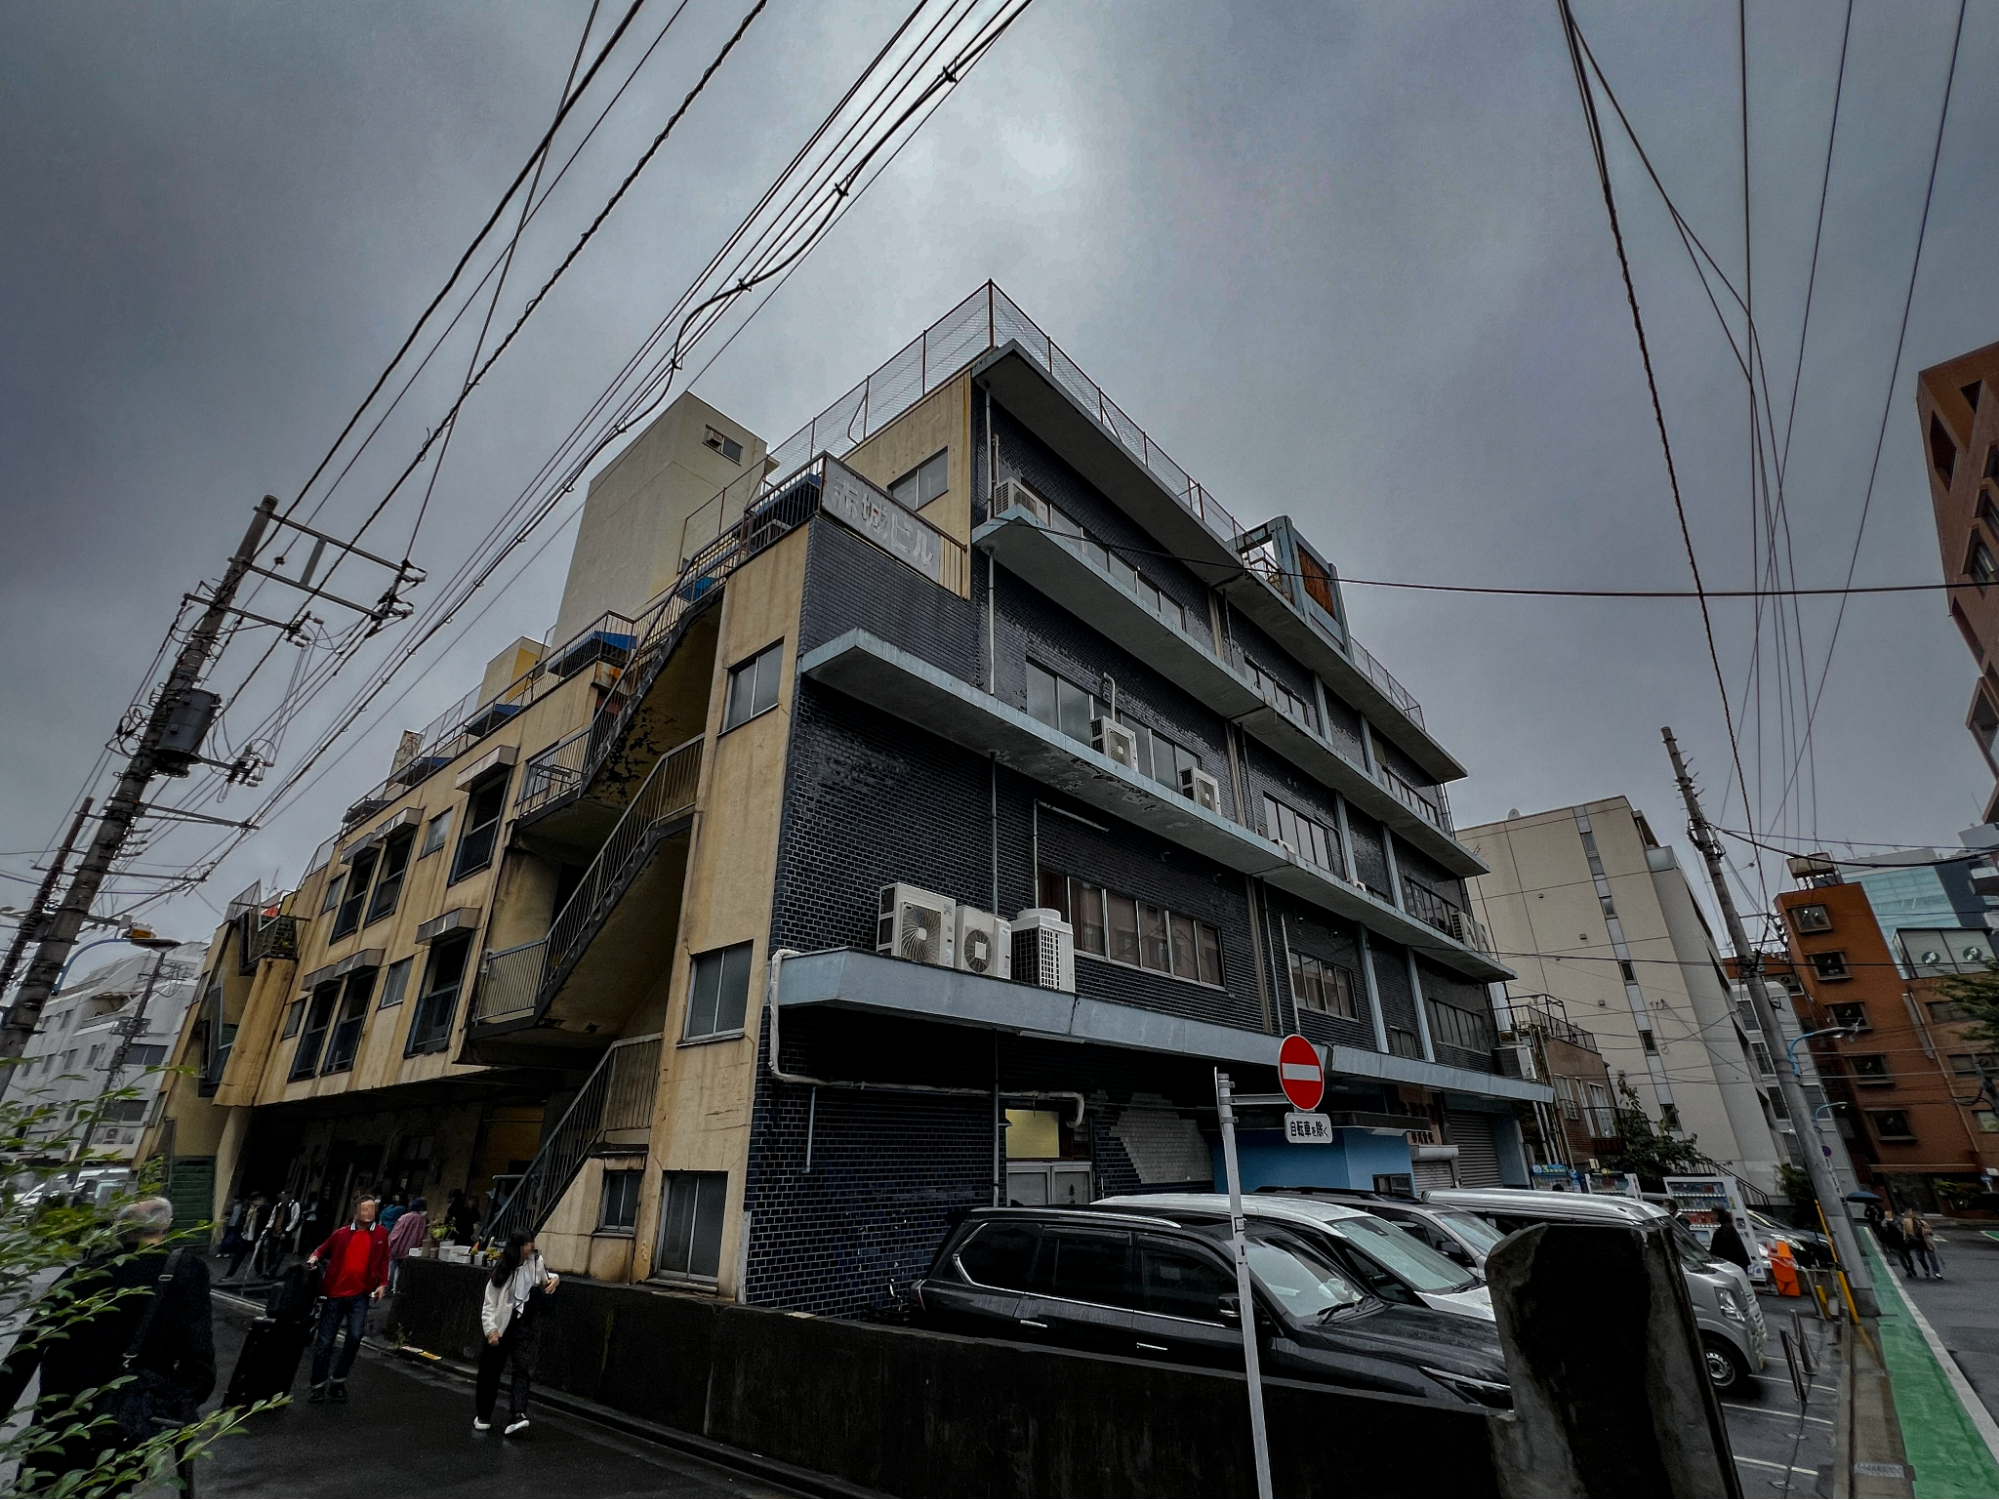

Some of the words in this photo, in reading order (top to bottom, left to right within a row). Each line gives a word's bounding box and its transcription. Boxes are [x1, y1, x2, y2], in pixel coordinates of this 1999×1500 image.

[1290, 1120, 1329, 1137] 自転車を除く
